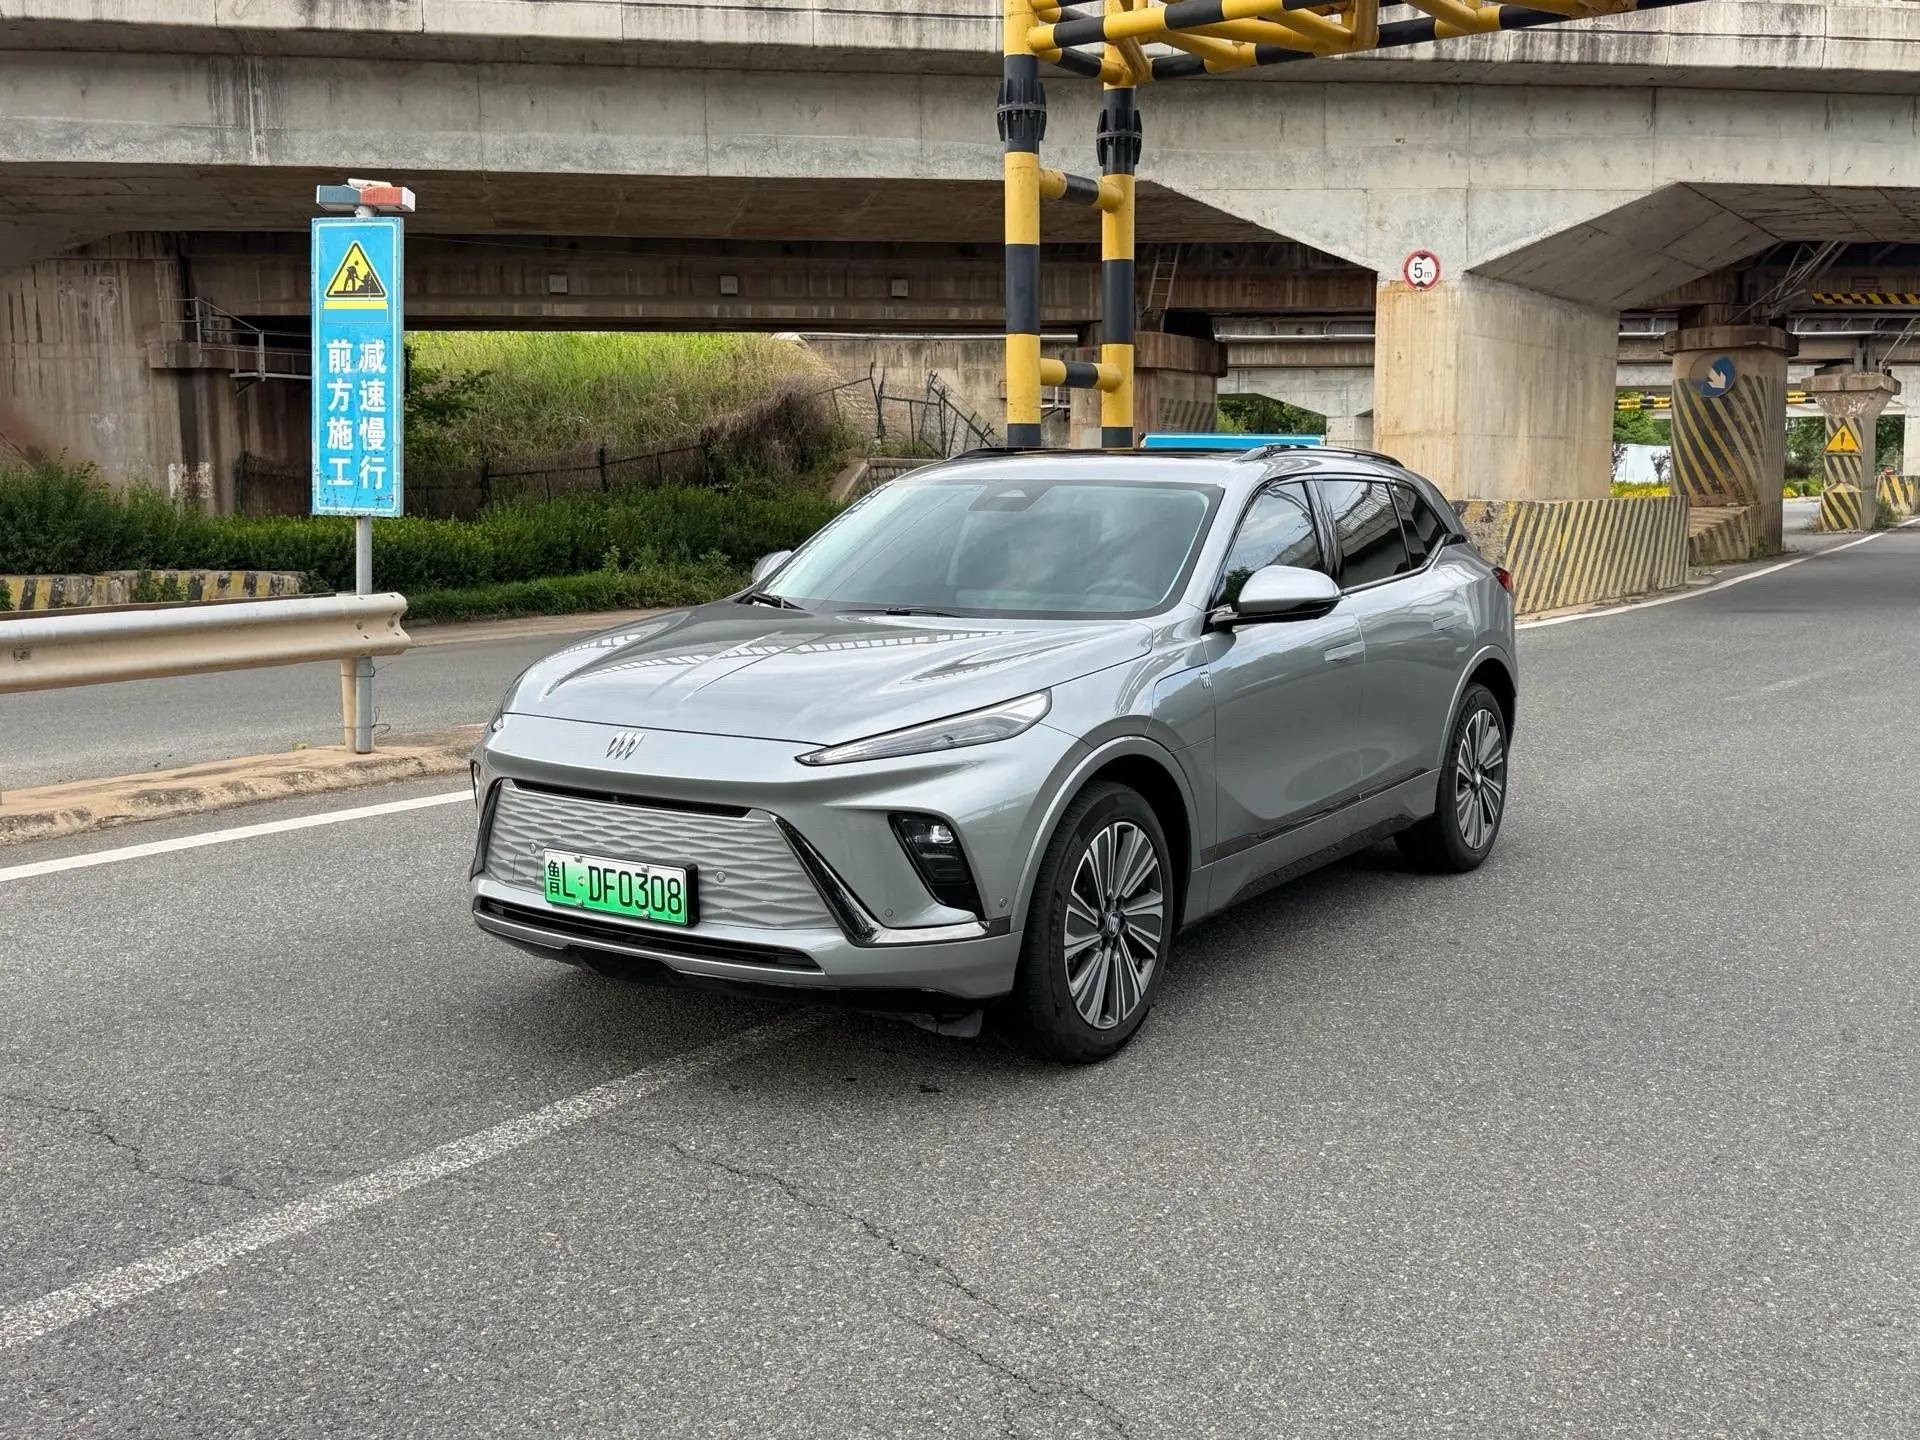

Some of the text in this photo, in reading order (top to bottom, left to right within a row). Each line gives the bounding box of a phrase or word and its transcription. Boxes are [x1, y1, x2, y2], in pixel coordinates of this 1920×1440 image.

[326, 338, 354, 487] 前方施工
[358, 338, 388, 491] 减速慢行
